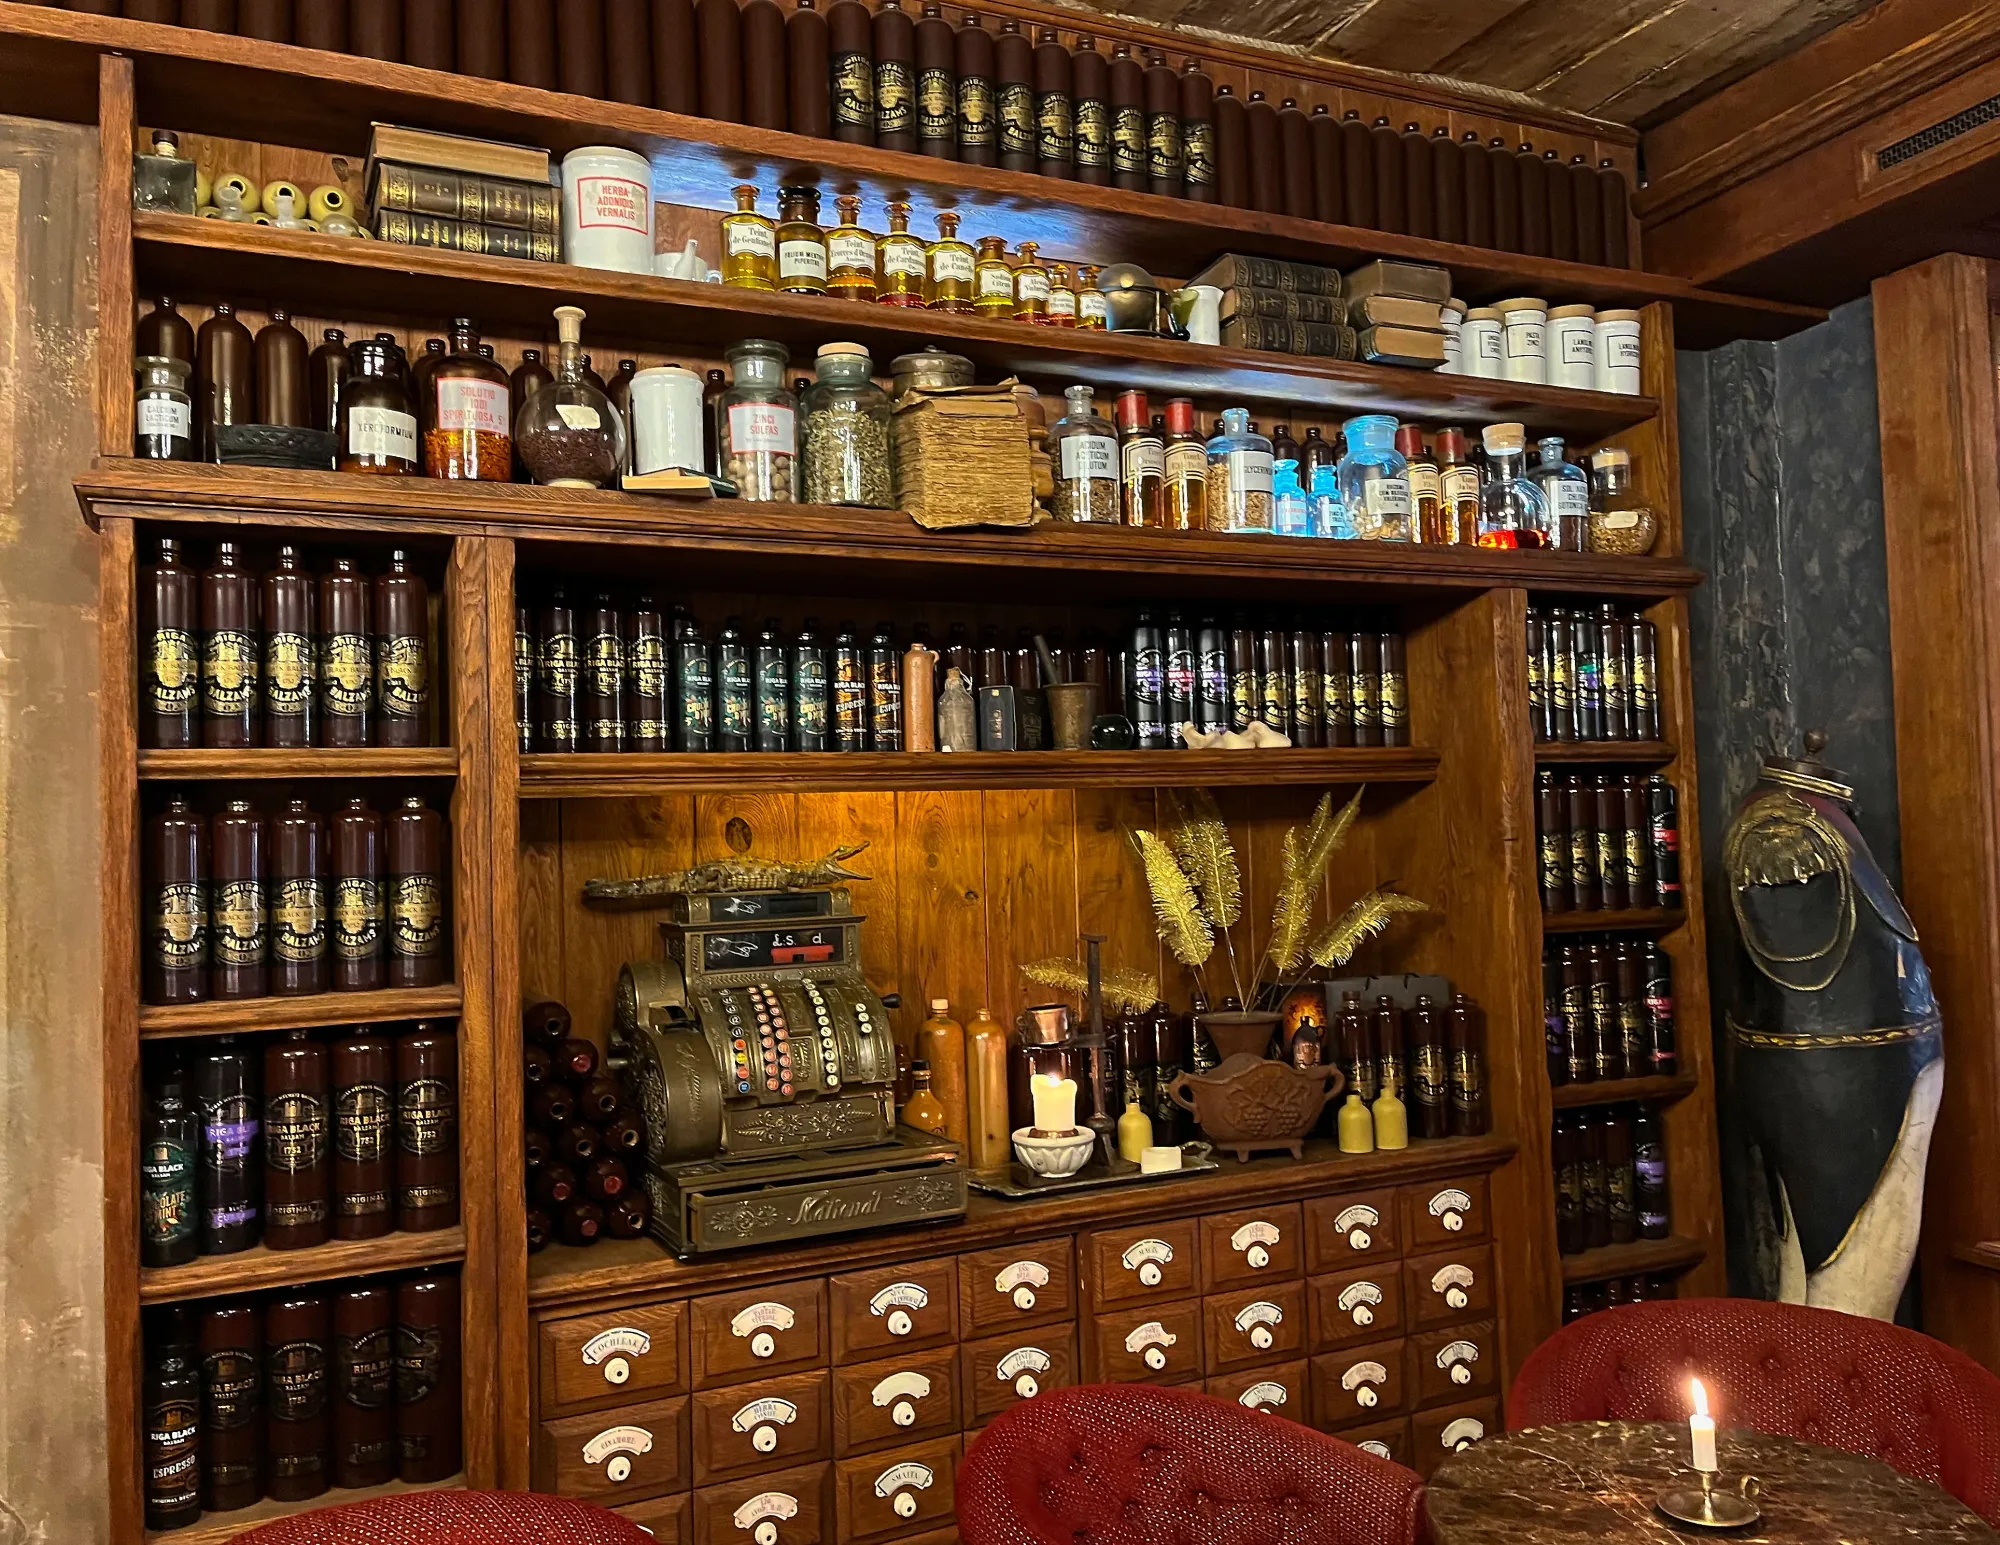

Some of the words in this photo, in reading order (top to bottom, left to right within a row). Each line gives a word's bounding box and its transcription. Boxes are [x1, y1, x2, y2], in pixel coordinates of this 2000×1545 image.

[602, 184, 630, 198] HERBA
[596, 196, 634, 210] ADONIDIS
[596, 206, 636, 222] VERNALIS
[340, 1116, 362, 1126] RIGA
[362, 1114, 390, 1125] BLACK
[402, 1109, 424, 1120] RIGA
[290, 1122, 320, 1134] BLACK
[359, 1136, 375, 1146] 1752
[418, 1130, 437, 1140] 1752
[283, 1146, 302, 1156] 1752
[158, 1162, 184, 1173] BLACK
[344, 1194, 386, 1204] ORIGINAL
[786, 1190, 883, 1225] National
[150, 1430, 172, 1442] RIGA
[172, 1424, 197, 1440] BLACK
[152, 1454, 196, 1480] ESPRESSO
